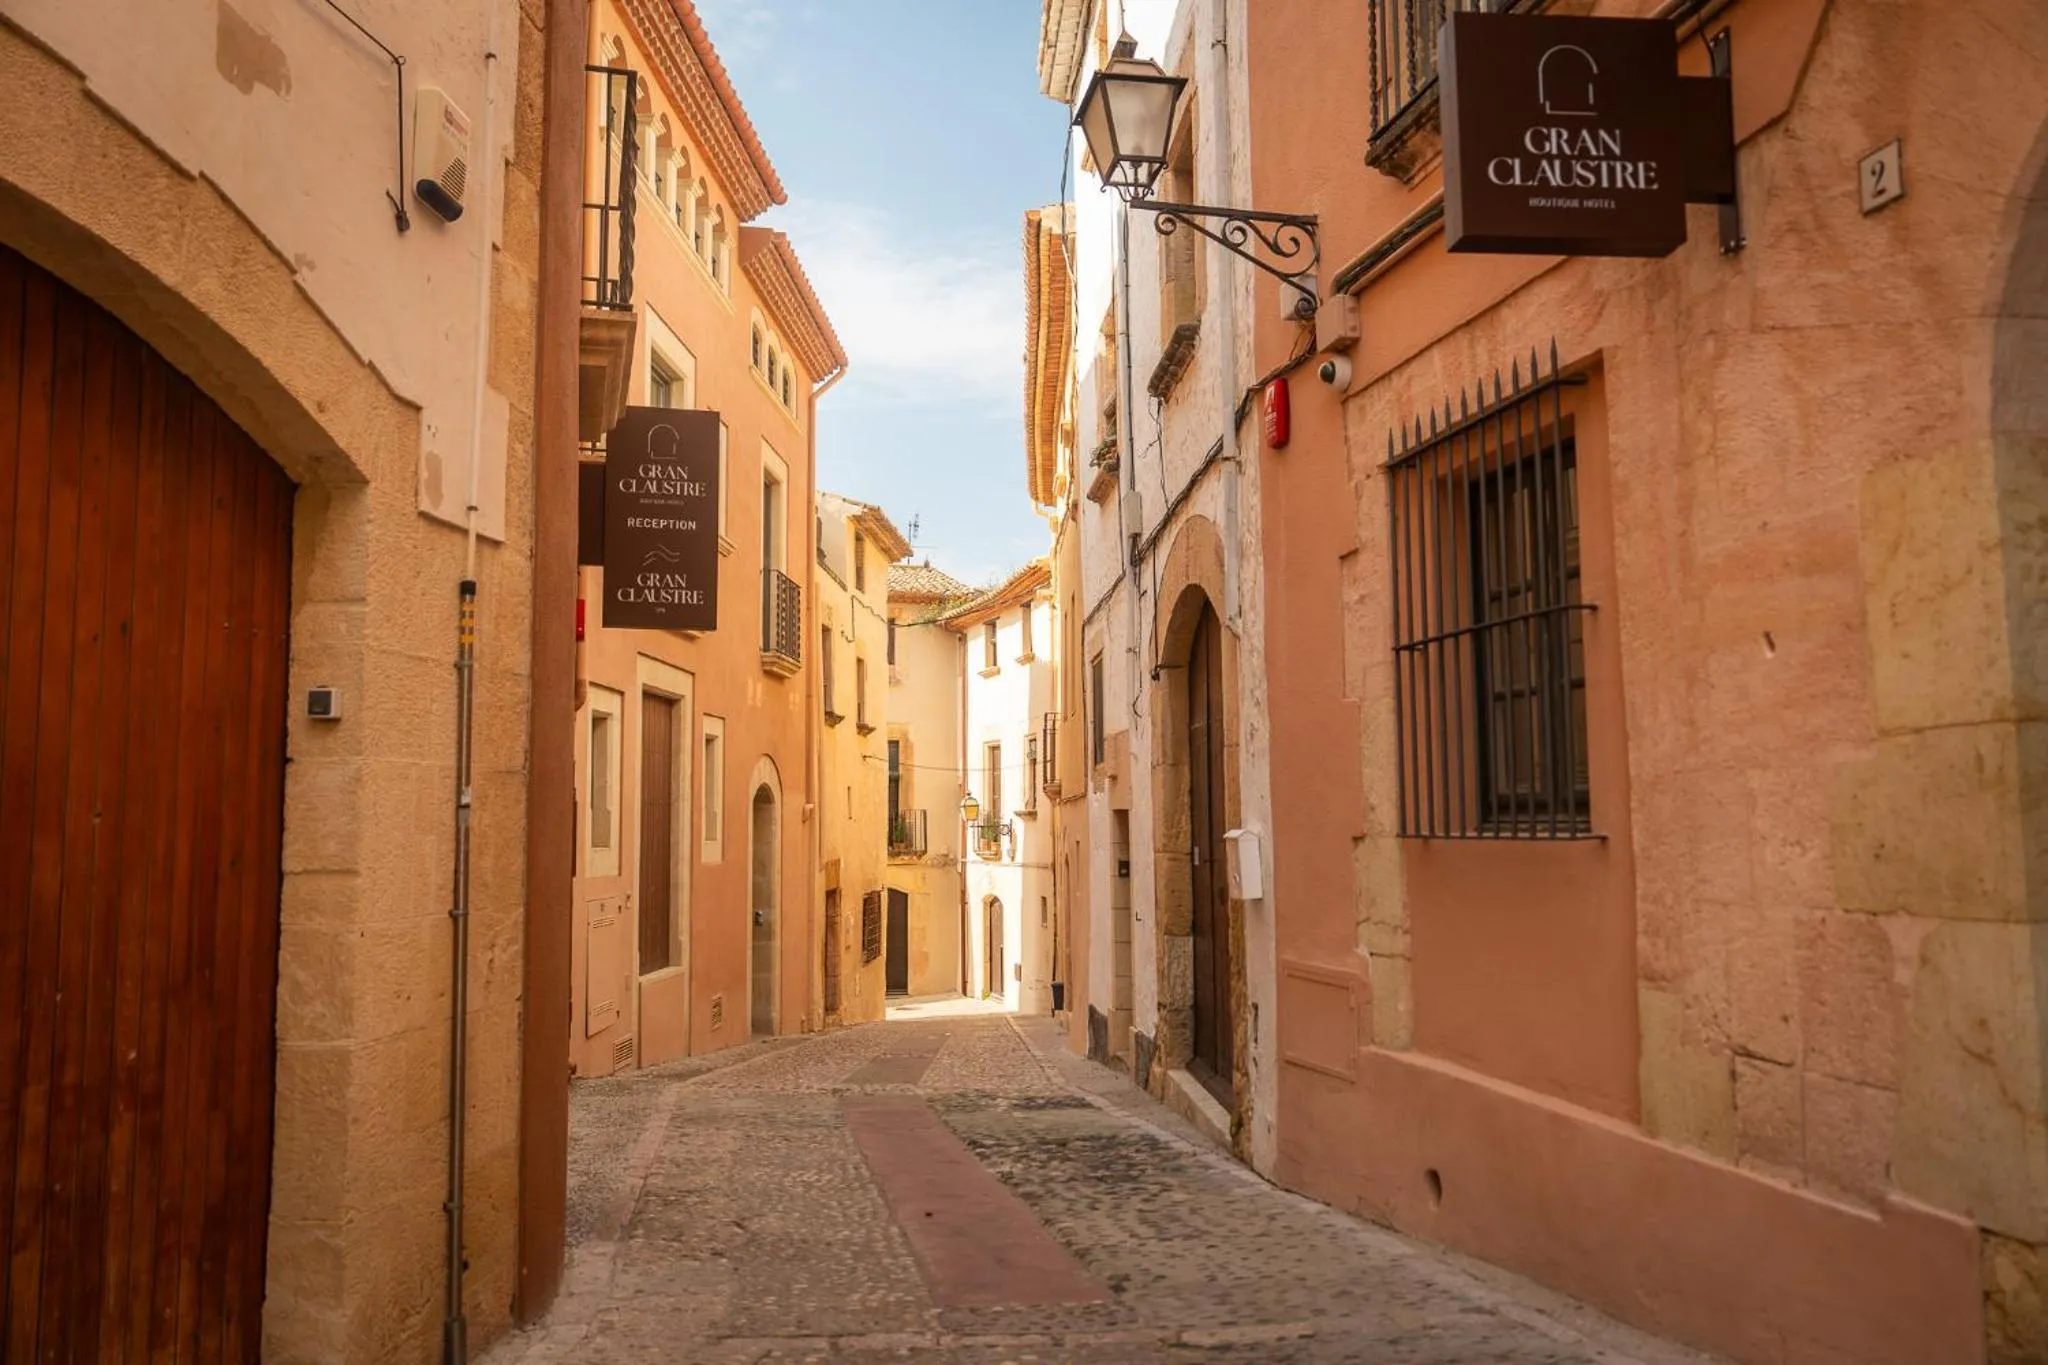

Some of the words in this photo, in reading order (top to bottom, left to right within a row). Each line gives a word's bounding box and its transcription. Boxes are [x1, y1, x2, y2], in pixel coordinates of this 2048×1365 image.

[1524, 126, 1621, 156] GRAN
[1488, 157, 1659, 190] CLAUSTRE
[1871, 160, 1887, 199] 2
[639, 464, 689, 480] GRAN
[619, 478, 706, 497] CLAUSTRE
[627, 517, 696, 531] RECEPTION
[637, 572, 688, 588] GRAN
[617, 587, 704, 605] CLAUSTRE
